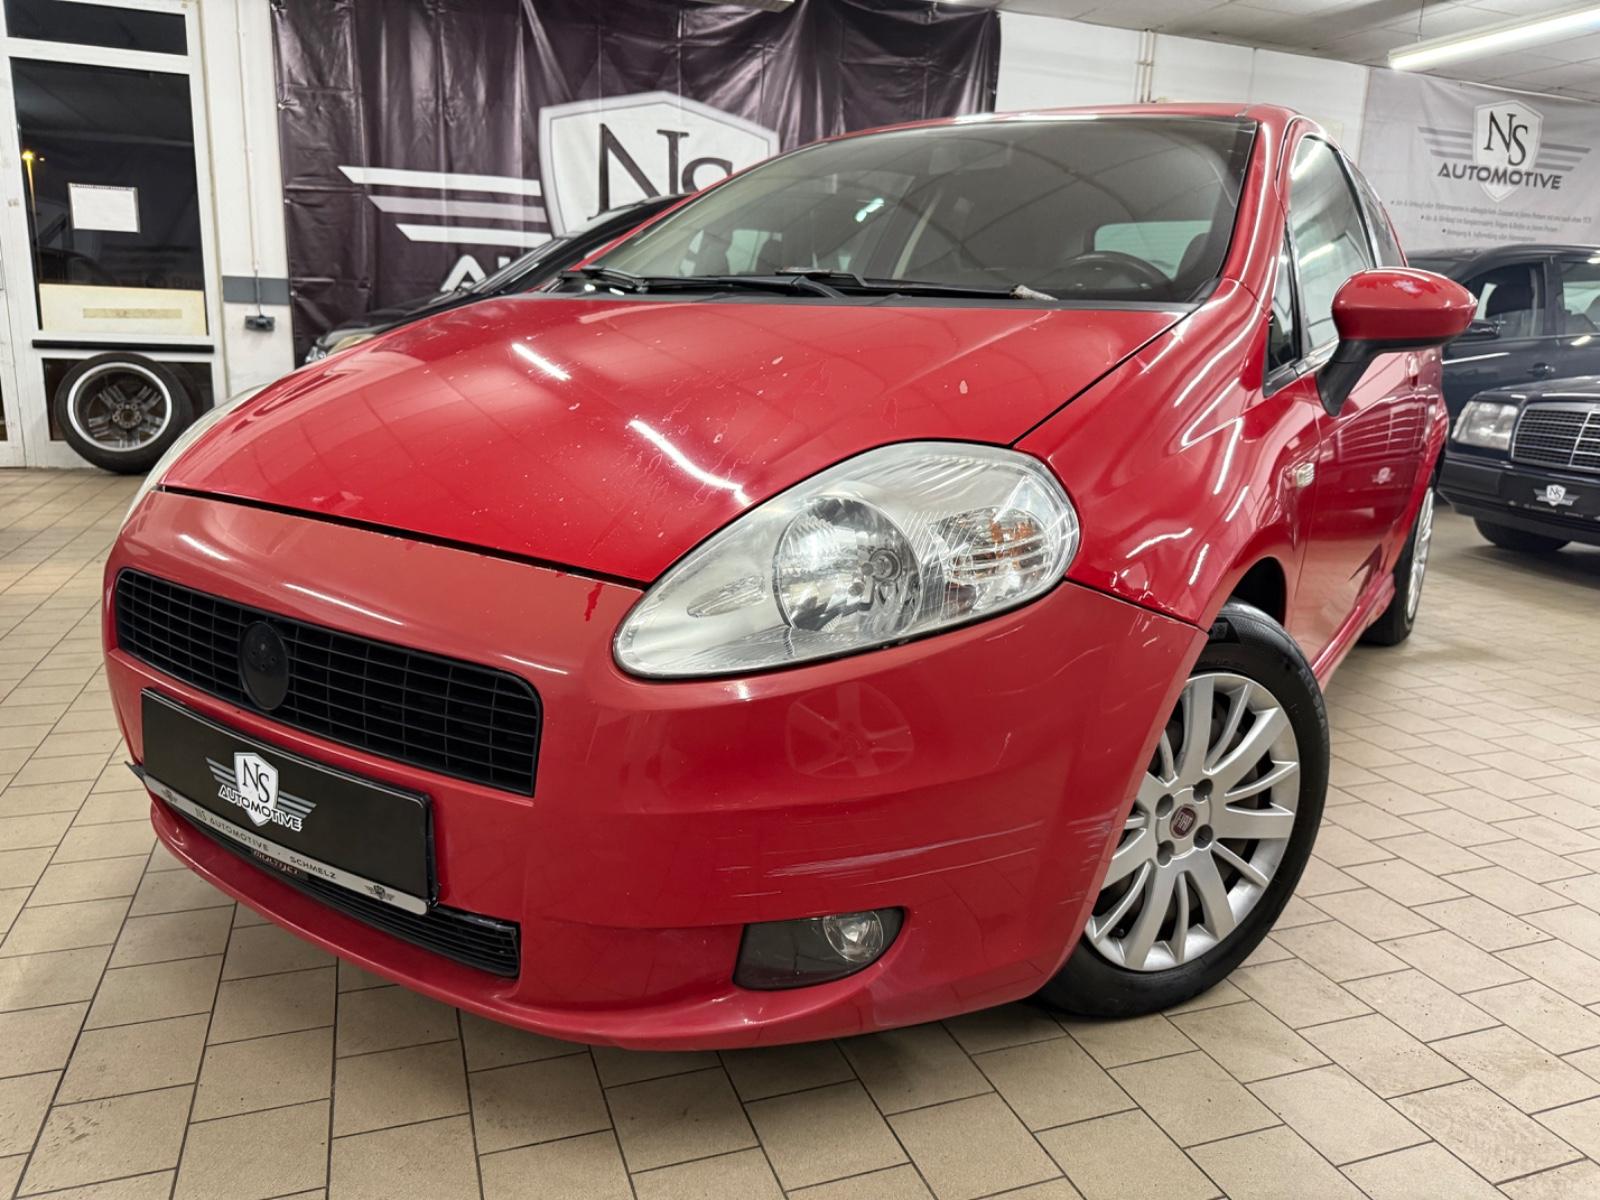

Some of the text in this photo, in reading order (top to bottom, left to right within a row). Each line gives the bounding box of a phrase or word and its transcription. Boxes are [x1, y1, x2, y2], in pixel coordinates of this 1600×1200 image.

[1484, 111, 1528, 166] NS
[1438, 163, 1562, 190] AUTOMOTIVE
[243, 758, 271, 803] NS
[219, 785, 302, 831] AUTOMOTIVE
[210, 817, 269, 850] AUTOMOTIVE
[290, 857, 336, 878] SCHMELZ
